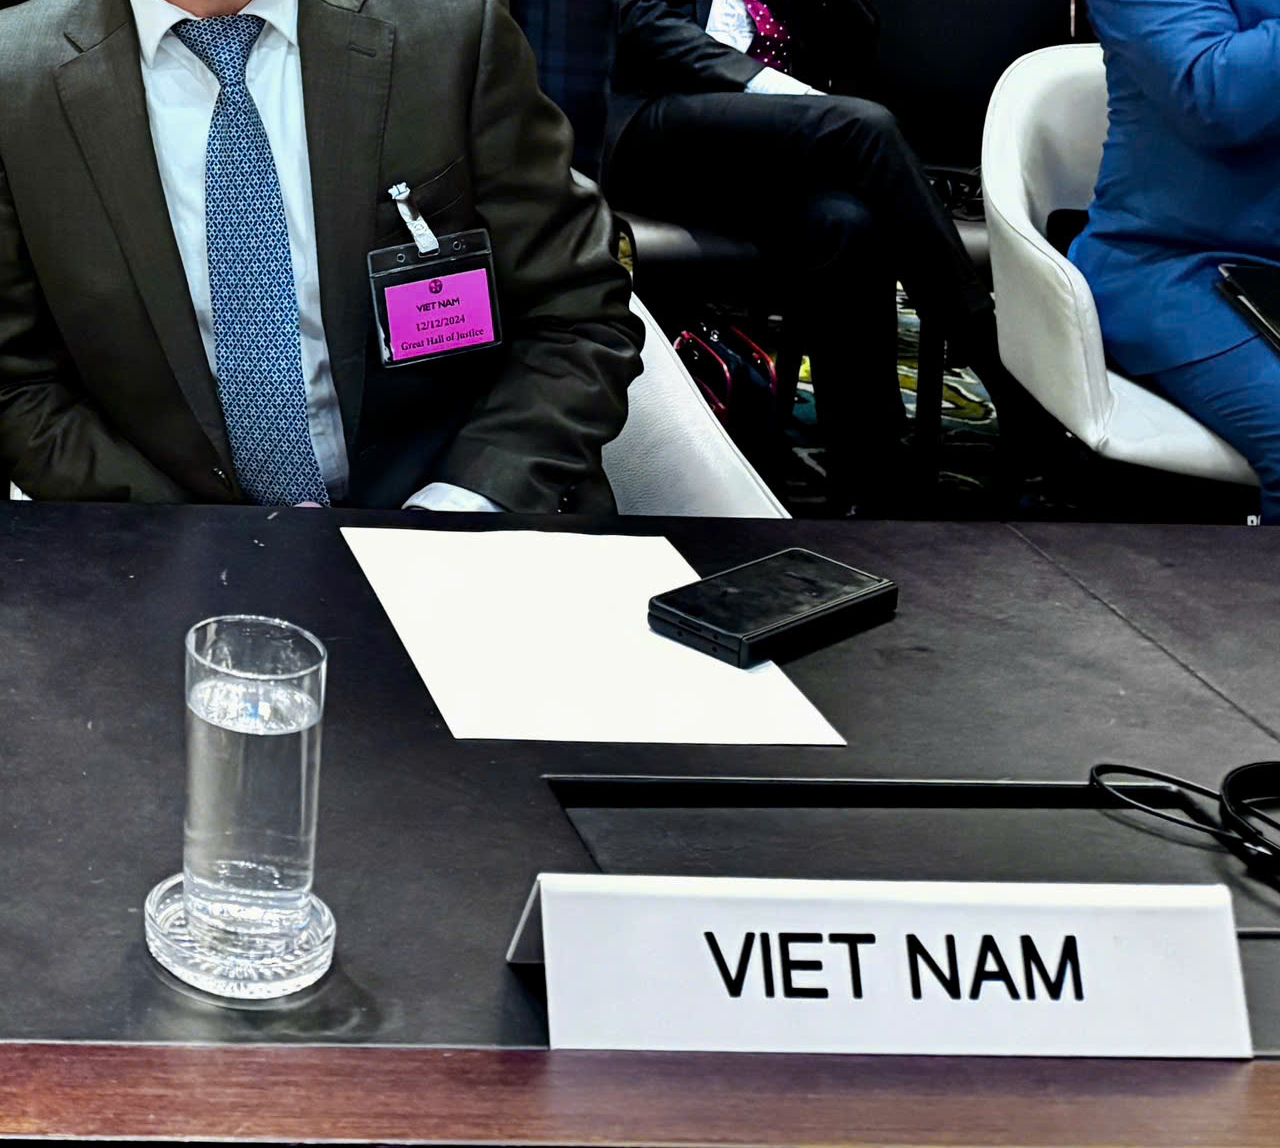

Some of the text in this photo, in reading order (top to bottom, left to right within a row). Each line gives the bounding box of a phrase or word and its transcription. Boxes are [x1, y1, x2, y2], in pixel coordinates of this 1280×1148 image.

[416, 297, 460, 313] VIET NAM
[416, 314, 465, 332] 12/12/2024
[400, 328, 484, 351] Great Hall of Justice
[704, 931, 1084, 1001] VIET NAM
